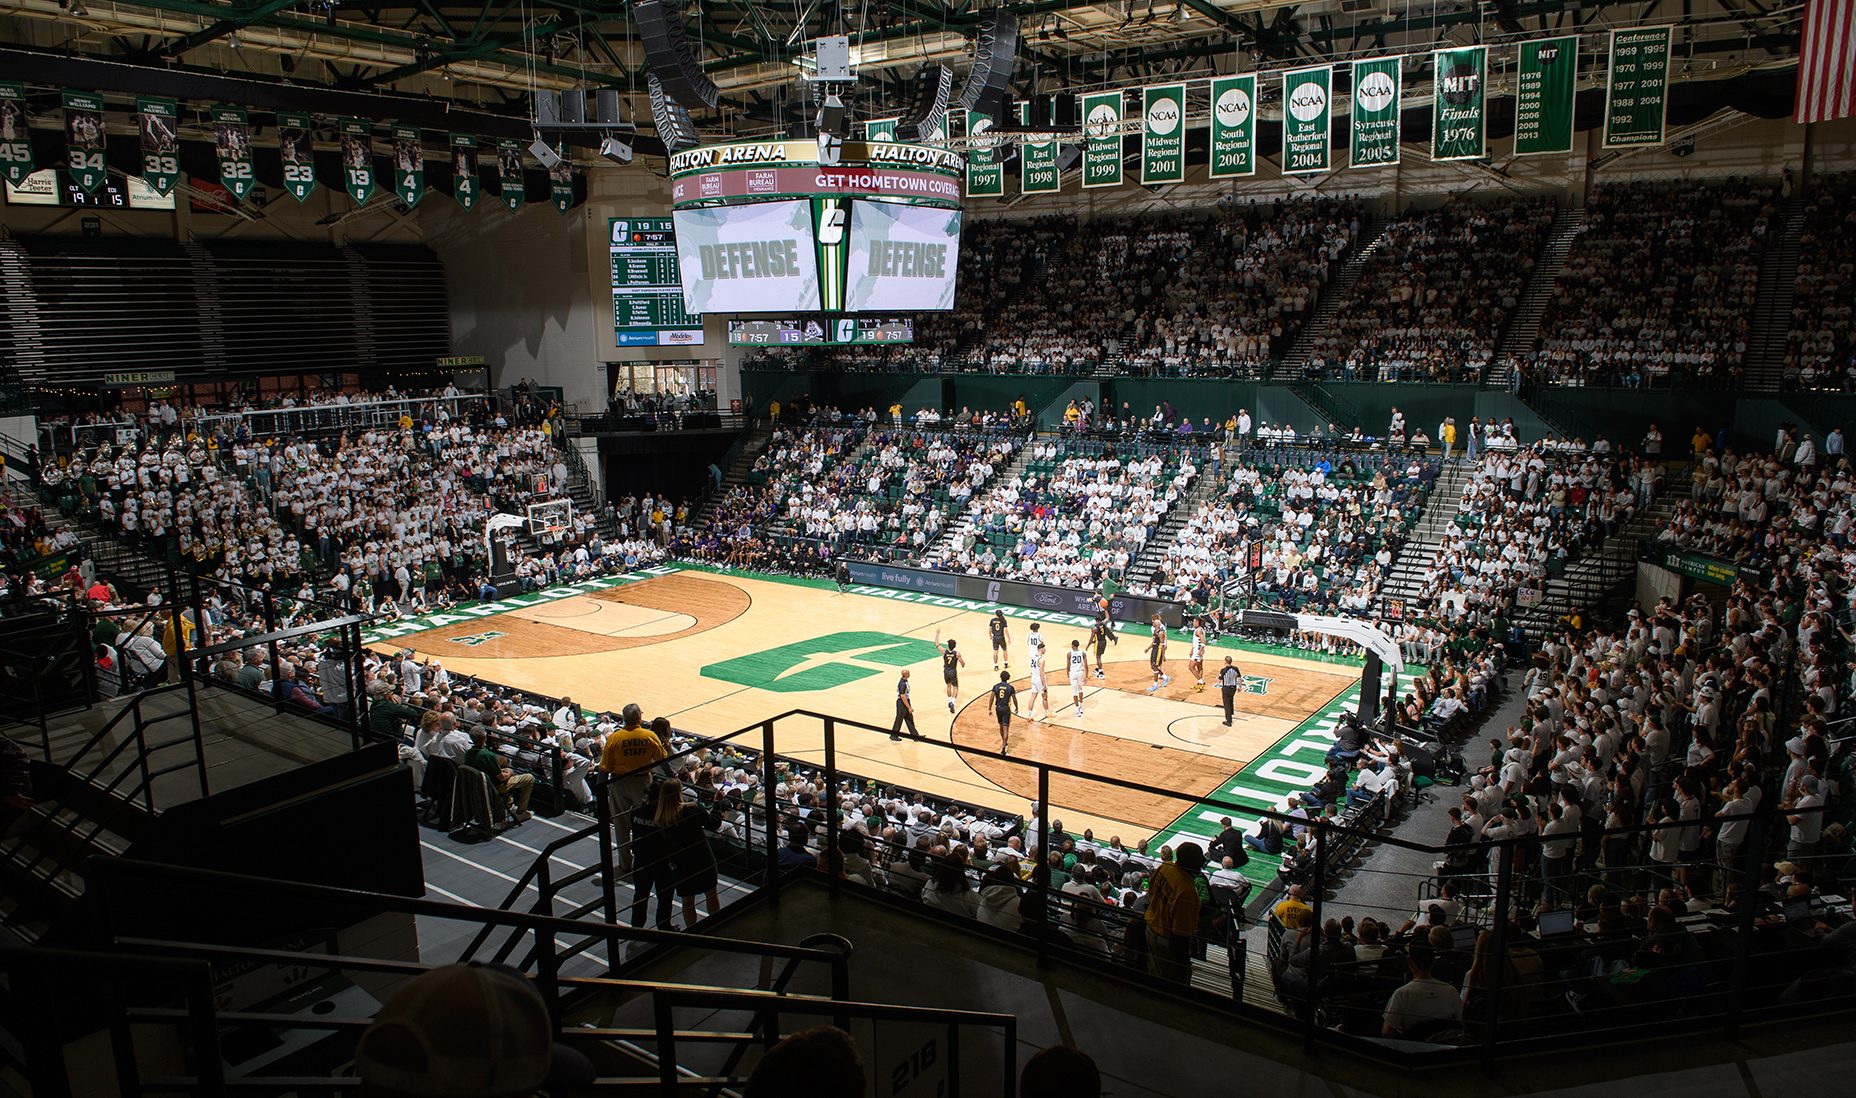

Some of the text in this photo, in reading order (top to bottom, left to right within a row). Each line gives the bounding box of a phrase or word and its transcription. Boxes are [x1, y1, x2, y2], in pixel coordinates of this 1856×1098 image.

[1616, 31, 1668, 43] Conference
[1538, 48, 1558, 60] NIT
[1616, 45, 1666, 57] 1969 1995
[1615, 61, 1665, 74] 1970 1999
[1521, 72, 1542, 81] 1976
[1443, 74, 1478, 94] NIT
[1520, 82, 1541, 91] 1989
[1614, 79, 1663, 92] 1977 2001
[1358, 85, 1392, 98] NCAA
[1520, 92, 1541, 101] 1994
[1217, 100, 1249, 114] NCAA
[1290, 95, 1324, 109] NCAA
[1519, 102, 1541, 111] 2000
[1612, 96, 1662, 108] 1988 2004
[143, 107, 171, 115] MAXWELL
[1149, 111, 1178, 122] NCAA
[1439, 107, 1481, 121] Finals
[1519, 112, 1541, 121] 2006
[1354, 119, 1397, 131] Syracuse
[1611, 115, 1633, 125] 1992
[1299, 122, 1316, 132] East
[1518, 122, 1540, 131] 2008
[1221, 129, 1245, 140] South
[1287, 130, 1328, 142] Rutherford
[1359, 130, 1393, 142] Regional
[1442, 127, 1475, 142] 1976
[1518, 132, 1540, 141] 2013
[1610, 134, 1659, 144] Champions
[1088, 142, 1119, 152] Midwest
[1147, 137, 1180, 149] Midwest
[1215, 139, 1250, 151] Regional
[1291, 140, 1323, 151] Regional
[0, 142, 32, 162] 45
[670, 145, 786, 171] HALTON ARENA
[871, 145, 937, 163] HALTON
[1033, 151, 1049, 159] East
[1088, 152, 1119, 163] Regional
[1148, 148, 1179, 159] Regional
[1359, 146, 1392, 162] 2005
[70, 151, 104, 171] 34
[144, 155, 178, 174] 33
[976, 154, 993, 163] West
[1026, 160, 1055, 169] Regional
[1218, 154, 1246, 167] 2002
[1291, 153, 1323, 168] 2004
[221, 161, 253, 179] 32
[284, 164, 314, 182] 23
[971, 163, 1000, 172] Regional
[1090, 165, 1116, 177] 1999
[1150, 161, 1177, 173] 2001
[27, 178, 52, 186] Harris
[347, 169, 370, 186] 13
[402, 174, 415, 189] 4
[749, 178, 774, 186] BUREAU
[815, 174, 845, 188] GET
[848, 174, 927, 191] HOMETOWN
[973, 175, 997, 187] 1997
[1028, 171, 1053, 183] 1998
[29, 184, 53, 192] Teeter
[459, 179, 471, 194] 4
[701, 182, 719, 190] BUREAU
[72, 193, 85, 204] 19
[111, 195, 123, 205] 15
[637, 222, 650, 230] 19
[659, 222, 672, 230] 15
[645, 233, 663, 241] 7:57
[699, 239, 801, 280] DEFENSE
[867, 239, 947, 279] DEFENSE
[749, 332, 769, 342] 7:57
[784, 333, 799, 342] 15
[861, 331, 902, 341] 19 7:57
[106, 374, 149, 383] NINER
[881, 572, 911, 584] live fully
[850, 586, 988, 611] HALTON
[1038, 592, 1057, 604] Ford
[1077, 603, 1090, 611] ARE
[1111, 607, 1121, 615] OF
[995, 623, 1000, 631] 0
[1099, 627, 1105, 635] 3
[1030, 638, 1038, 646] 10
[946, 656, 952, 665] 7
[1072, 655, 1082, 664] 20
[1537, 672, 1549, 681] 49
[998, 690, 1005, 699] 6
[622, 737, 649, 747] EVENT
[623, 748, 648, 757] STAFF
[892, 1038, 937, 1096] 218
